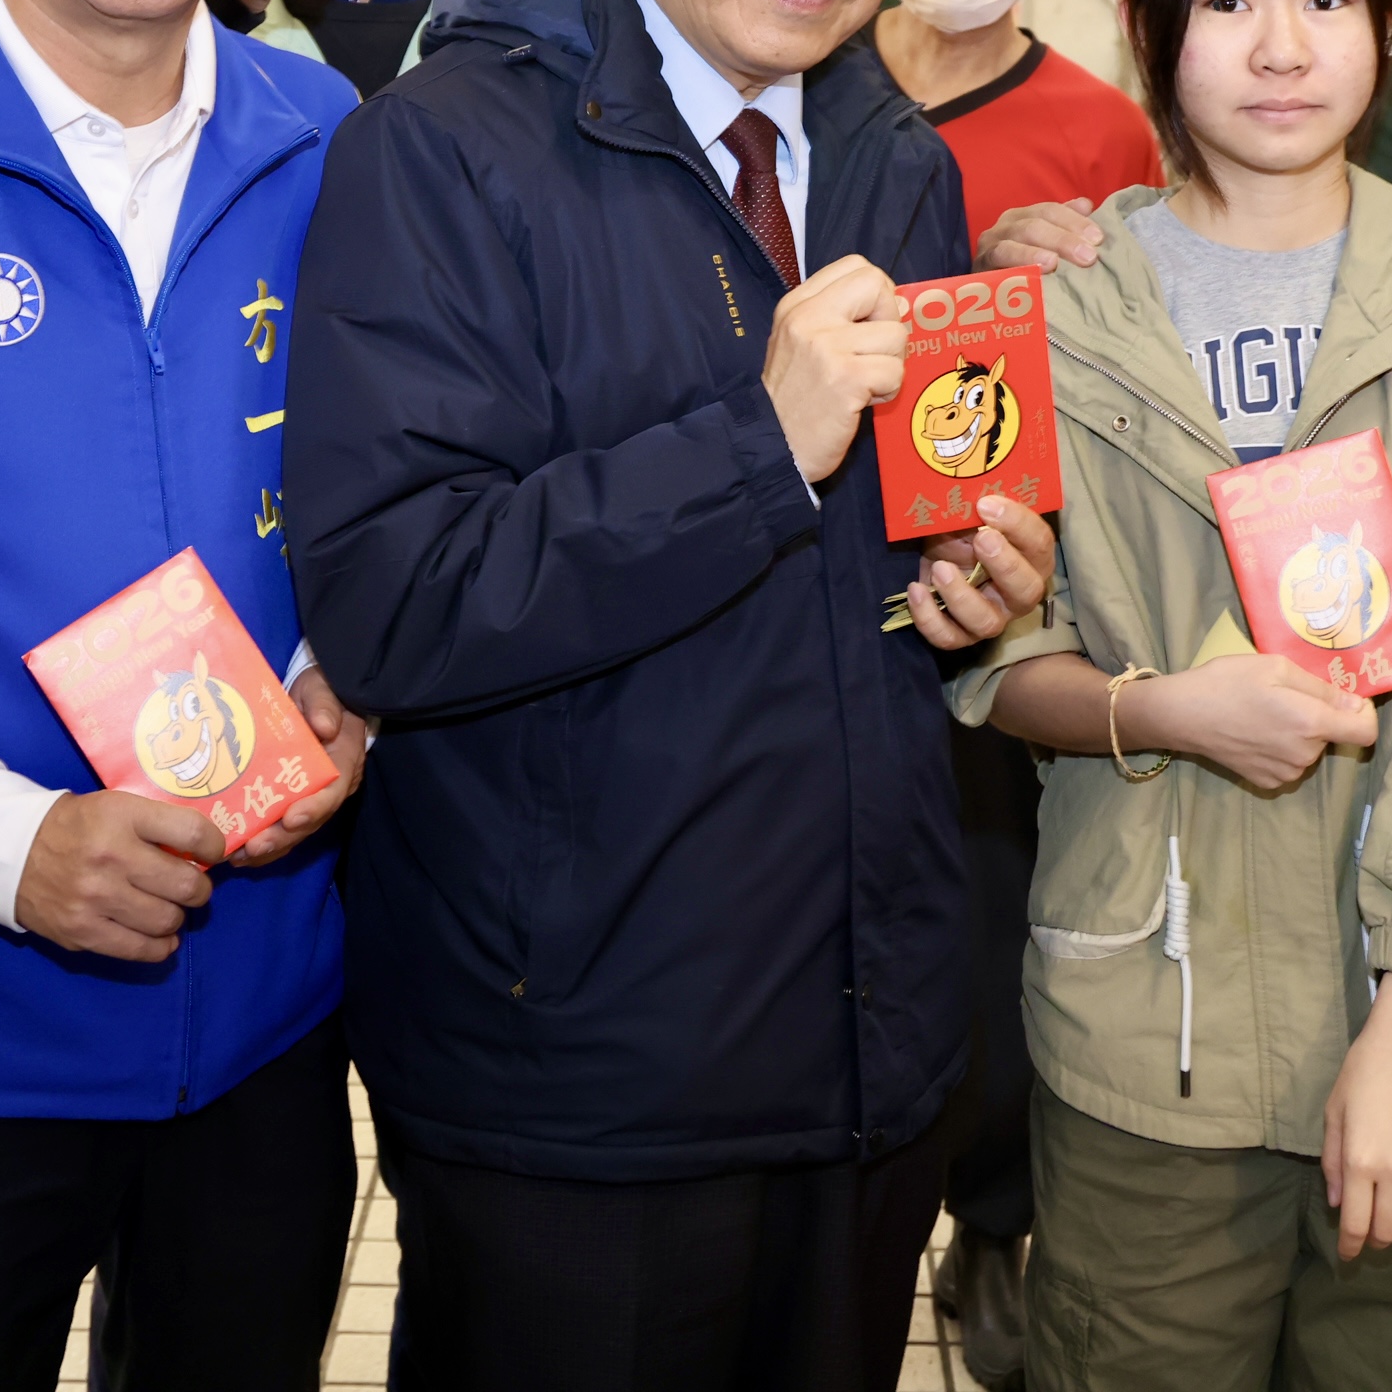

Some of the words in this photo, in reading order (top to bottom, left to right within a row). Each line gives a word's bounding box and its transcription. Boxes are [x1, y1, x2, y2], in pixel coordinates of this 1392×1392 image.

[946, 330, 987, 350] New
[992, 320, 1034, 341] Year
[1220, 441, 1379, 520] 2026
[1232, 511, 1296, 539] Happy
[1299, 498, 1338, 521] New
[1340, 485, 1385, 507] Year
[44, 564, 204, 692] 2026
[173, 605, 217, 640] Year
